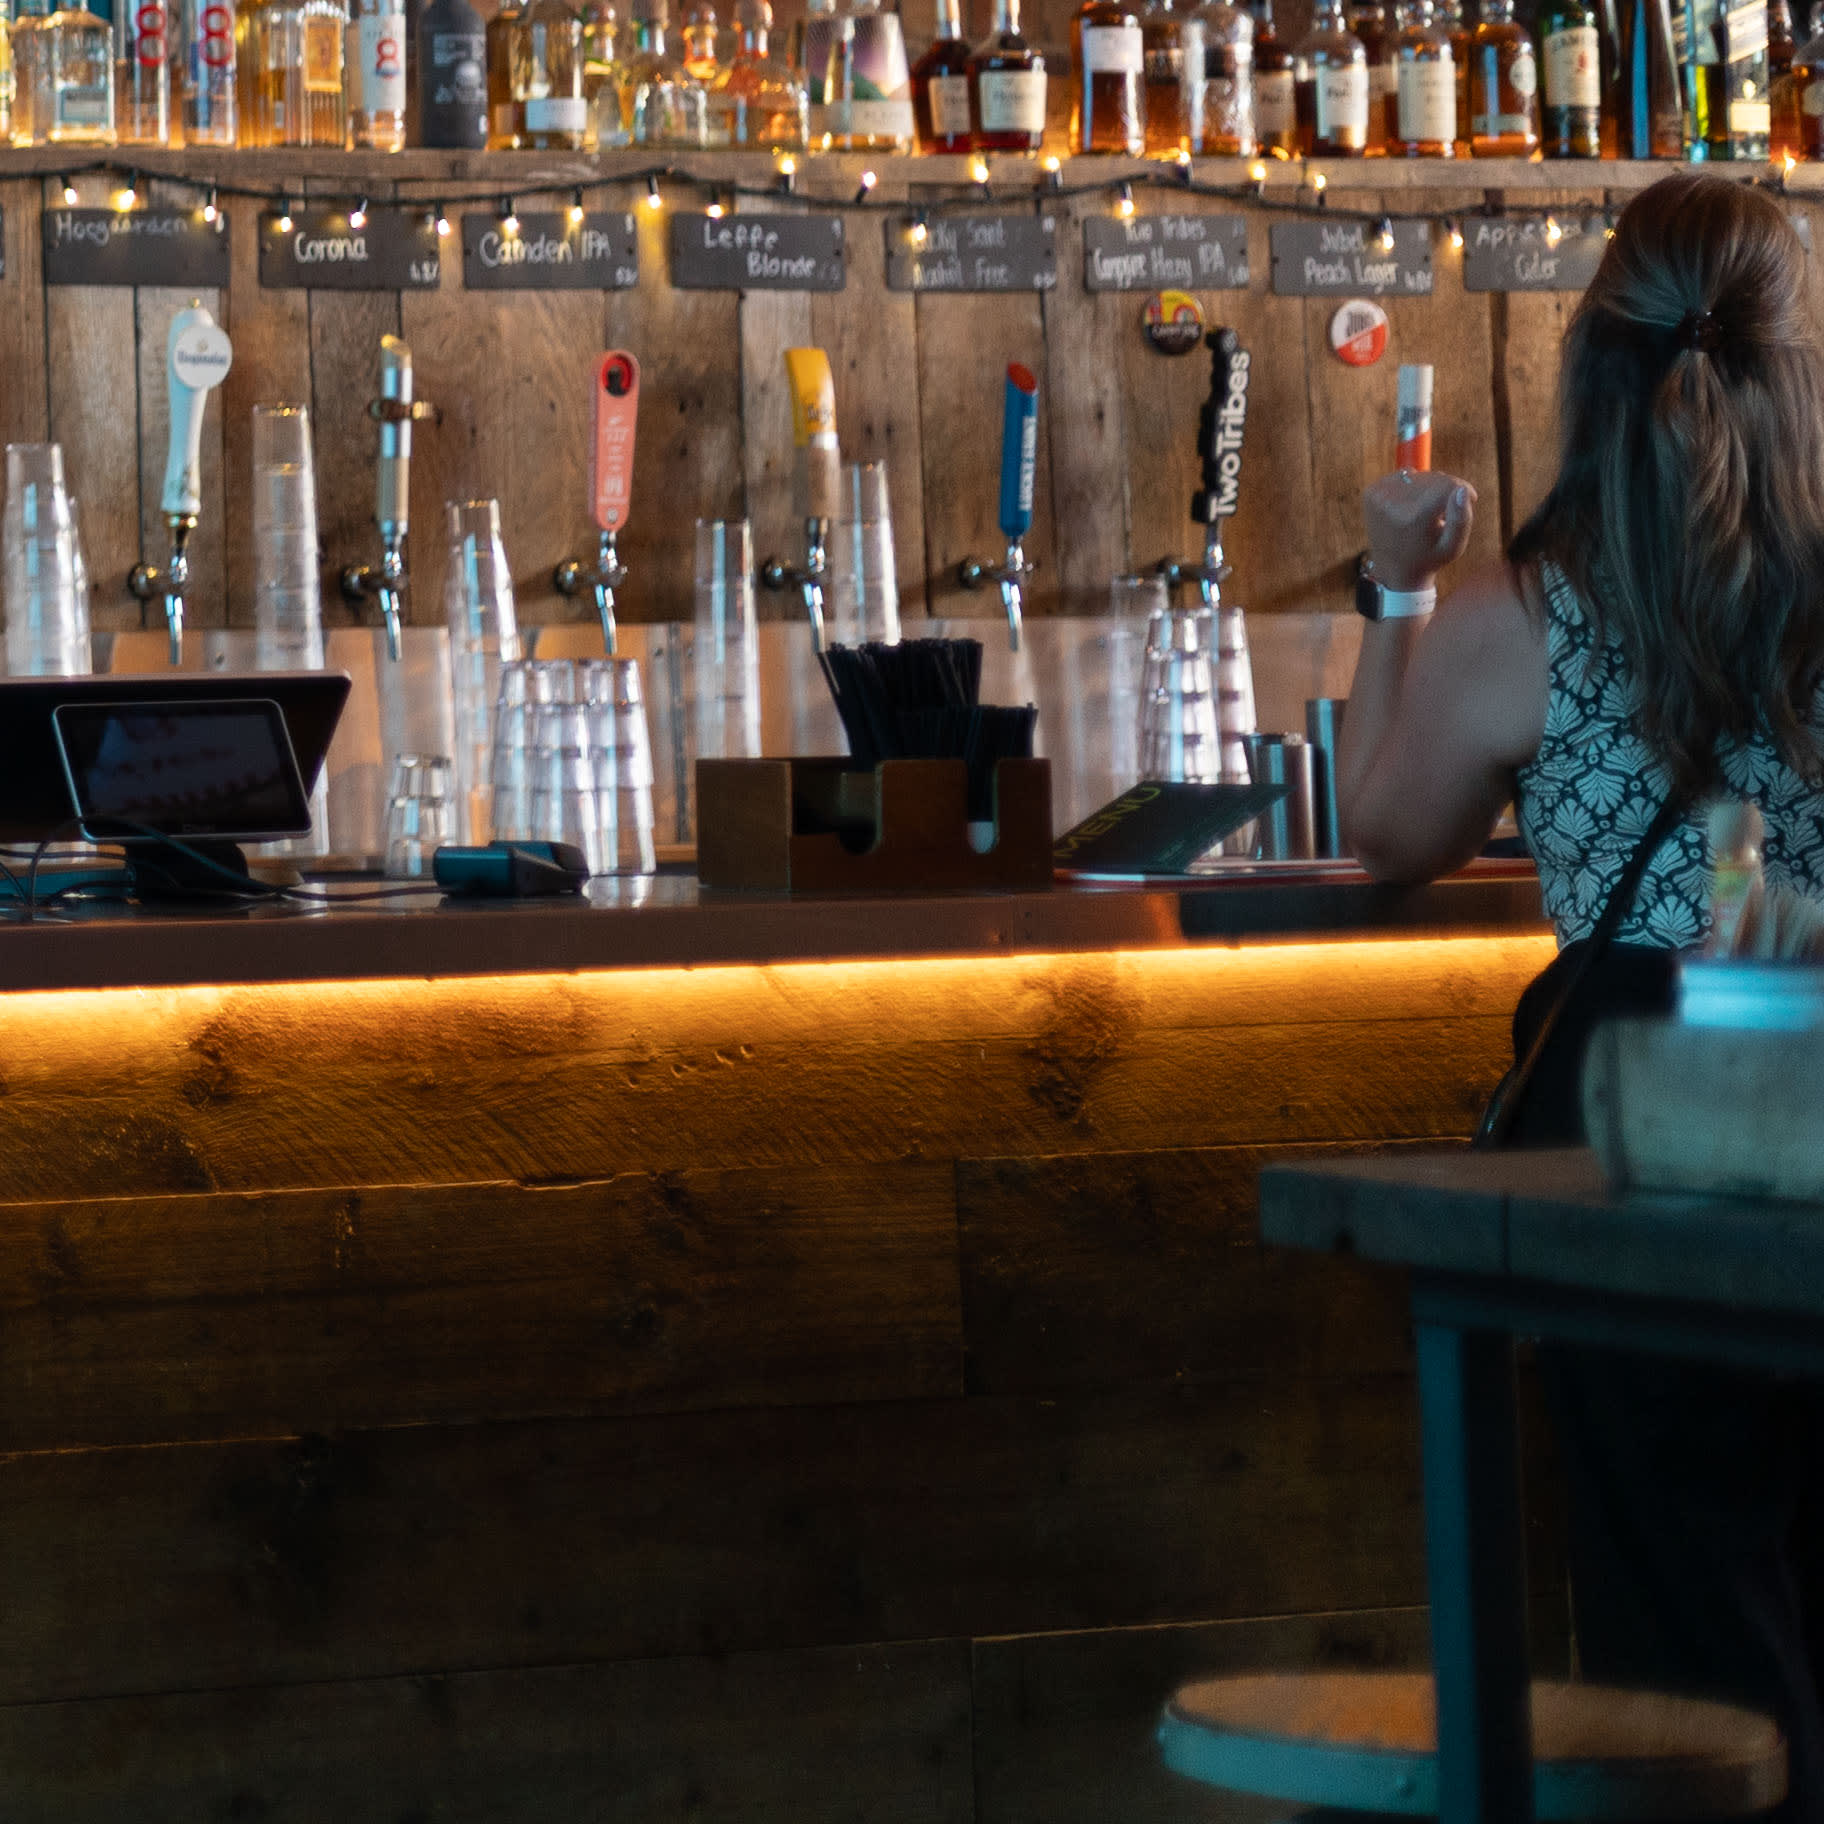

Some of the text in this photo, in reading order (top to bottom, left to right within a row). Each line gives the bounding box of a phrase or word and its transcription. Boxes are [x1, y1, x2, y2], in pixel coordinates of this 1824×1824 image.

[294, 231, 369, 264] Corona
[479, 230, 574, 267] Camden
[581, 226, 612, 261] IPA
[703, 220, 779, 250] Leffe
[747, 251, 817, 279] Blonde
[1053, 786, 1161, 858] MENU
